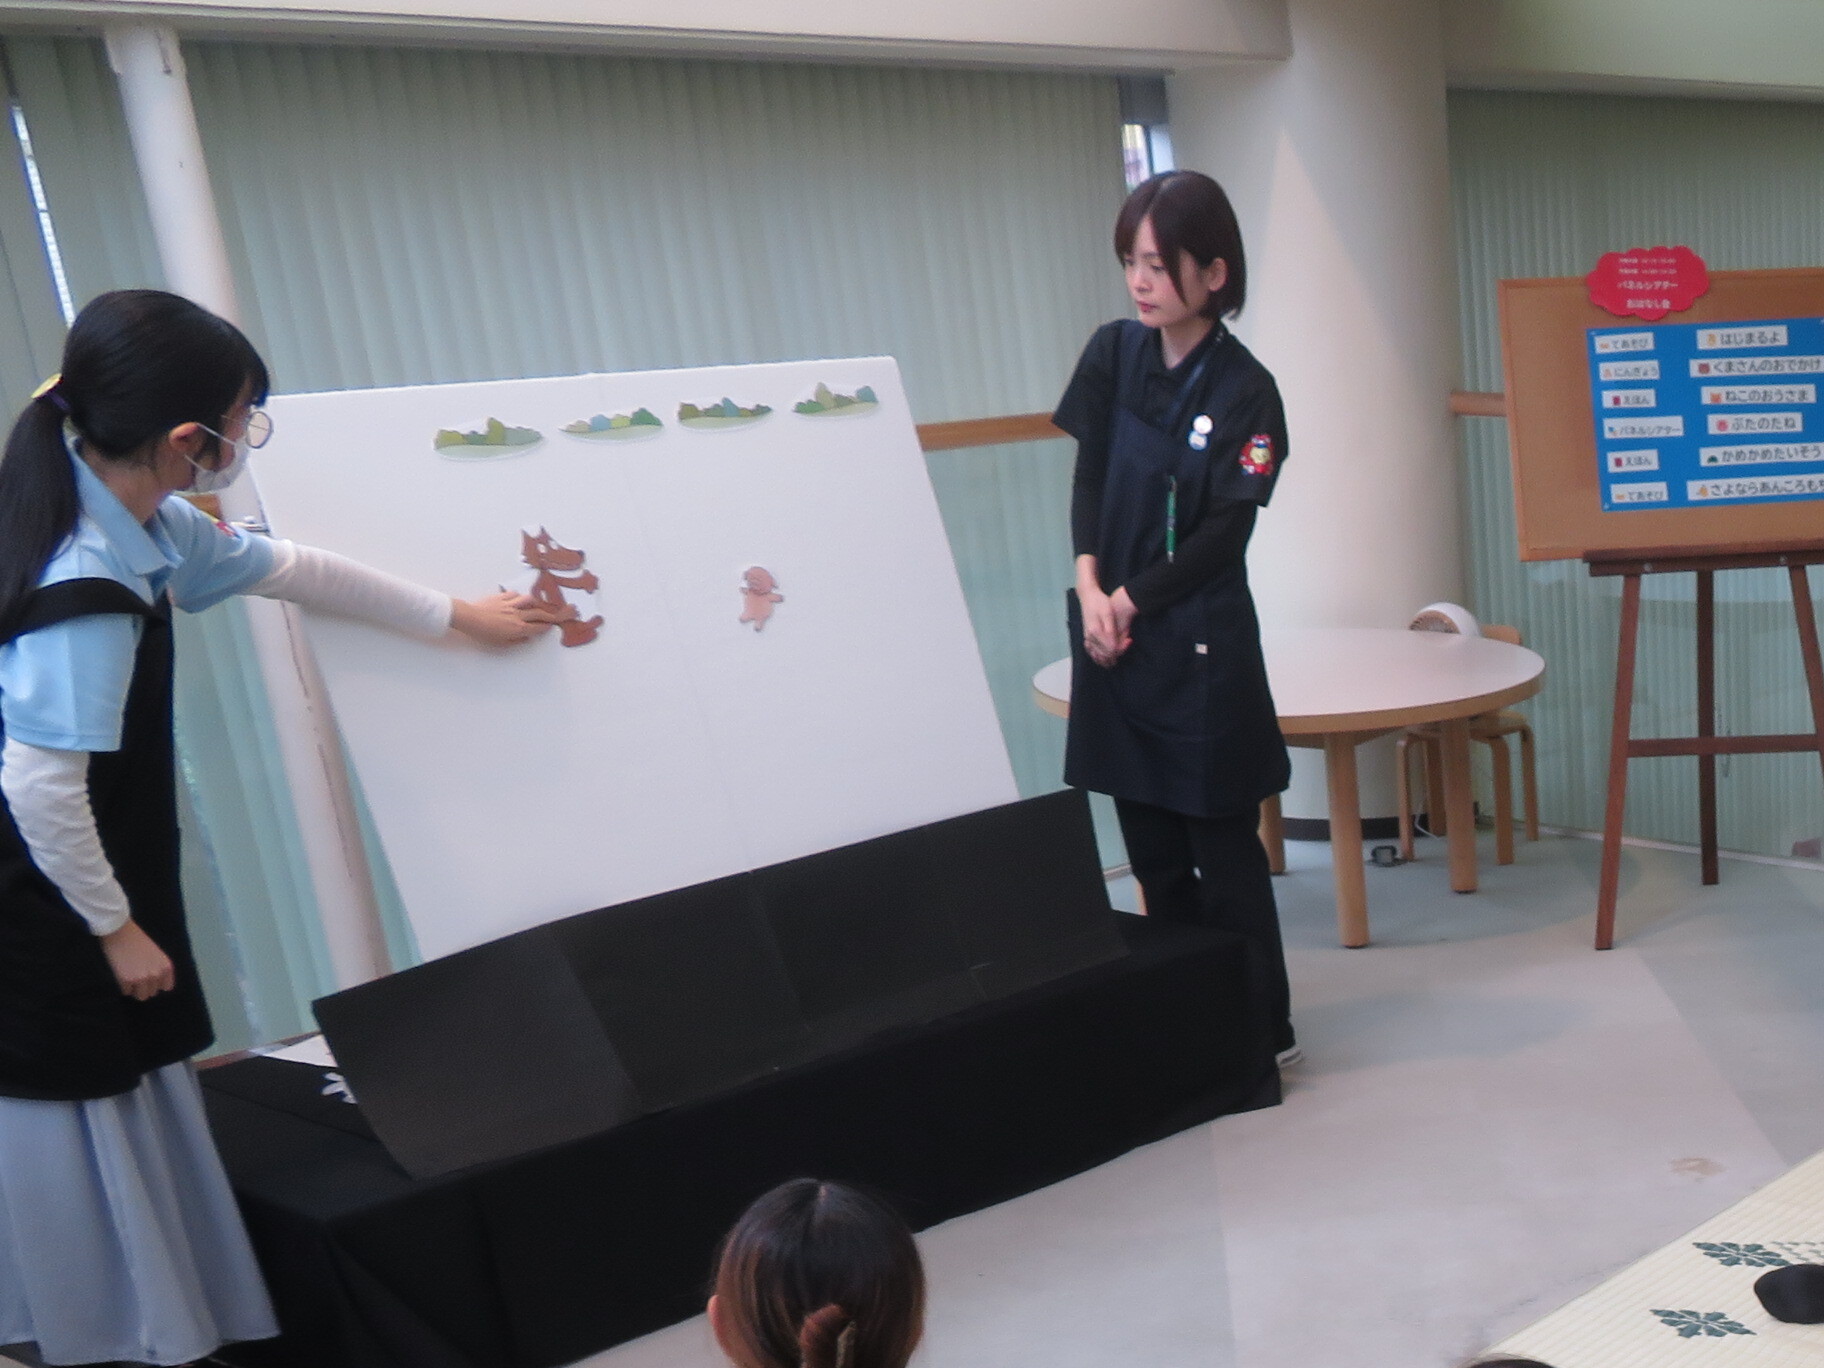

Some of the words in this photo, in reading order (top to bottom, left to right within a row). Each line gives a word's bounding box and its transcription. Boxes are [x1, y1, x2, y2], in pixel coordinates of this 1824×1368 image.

[1720, 331, 1780, 345] はじまるよ
[1612, 339, 1648, 349] てあそび
[1713, 358, 1820, 373] くまさんのおでかけ
[1614, 367, 1658, 377] にんぎょう
[1624, 395, 1649, 404] えほん
[1726, 390, 1809, 401] ねこのおうさま
[1732, 417, 1797, 430] ぶたのたね
[1620, 426, 1680, 435] パネルシアター
[1722, 446, 1822, 462] かめかめたいそう
[1625, 456, 1651, 466] えほん
[1628, 490, 1663, 500] てあそび
